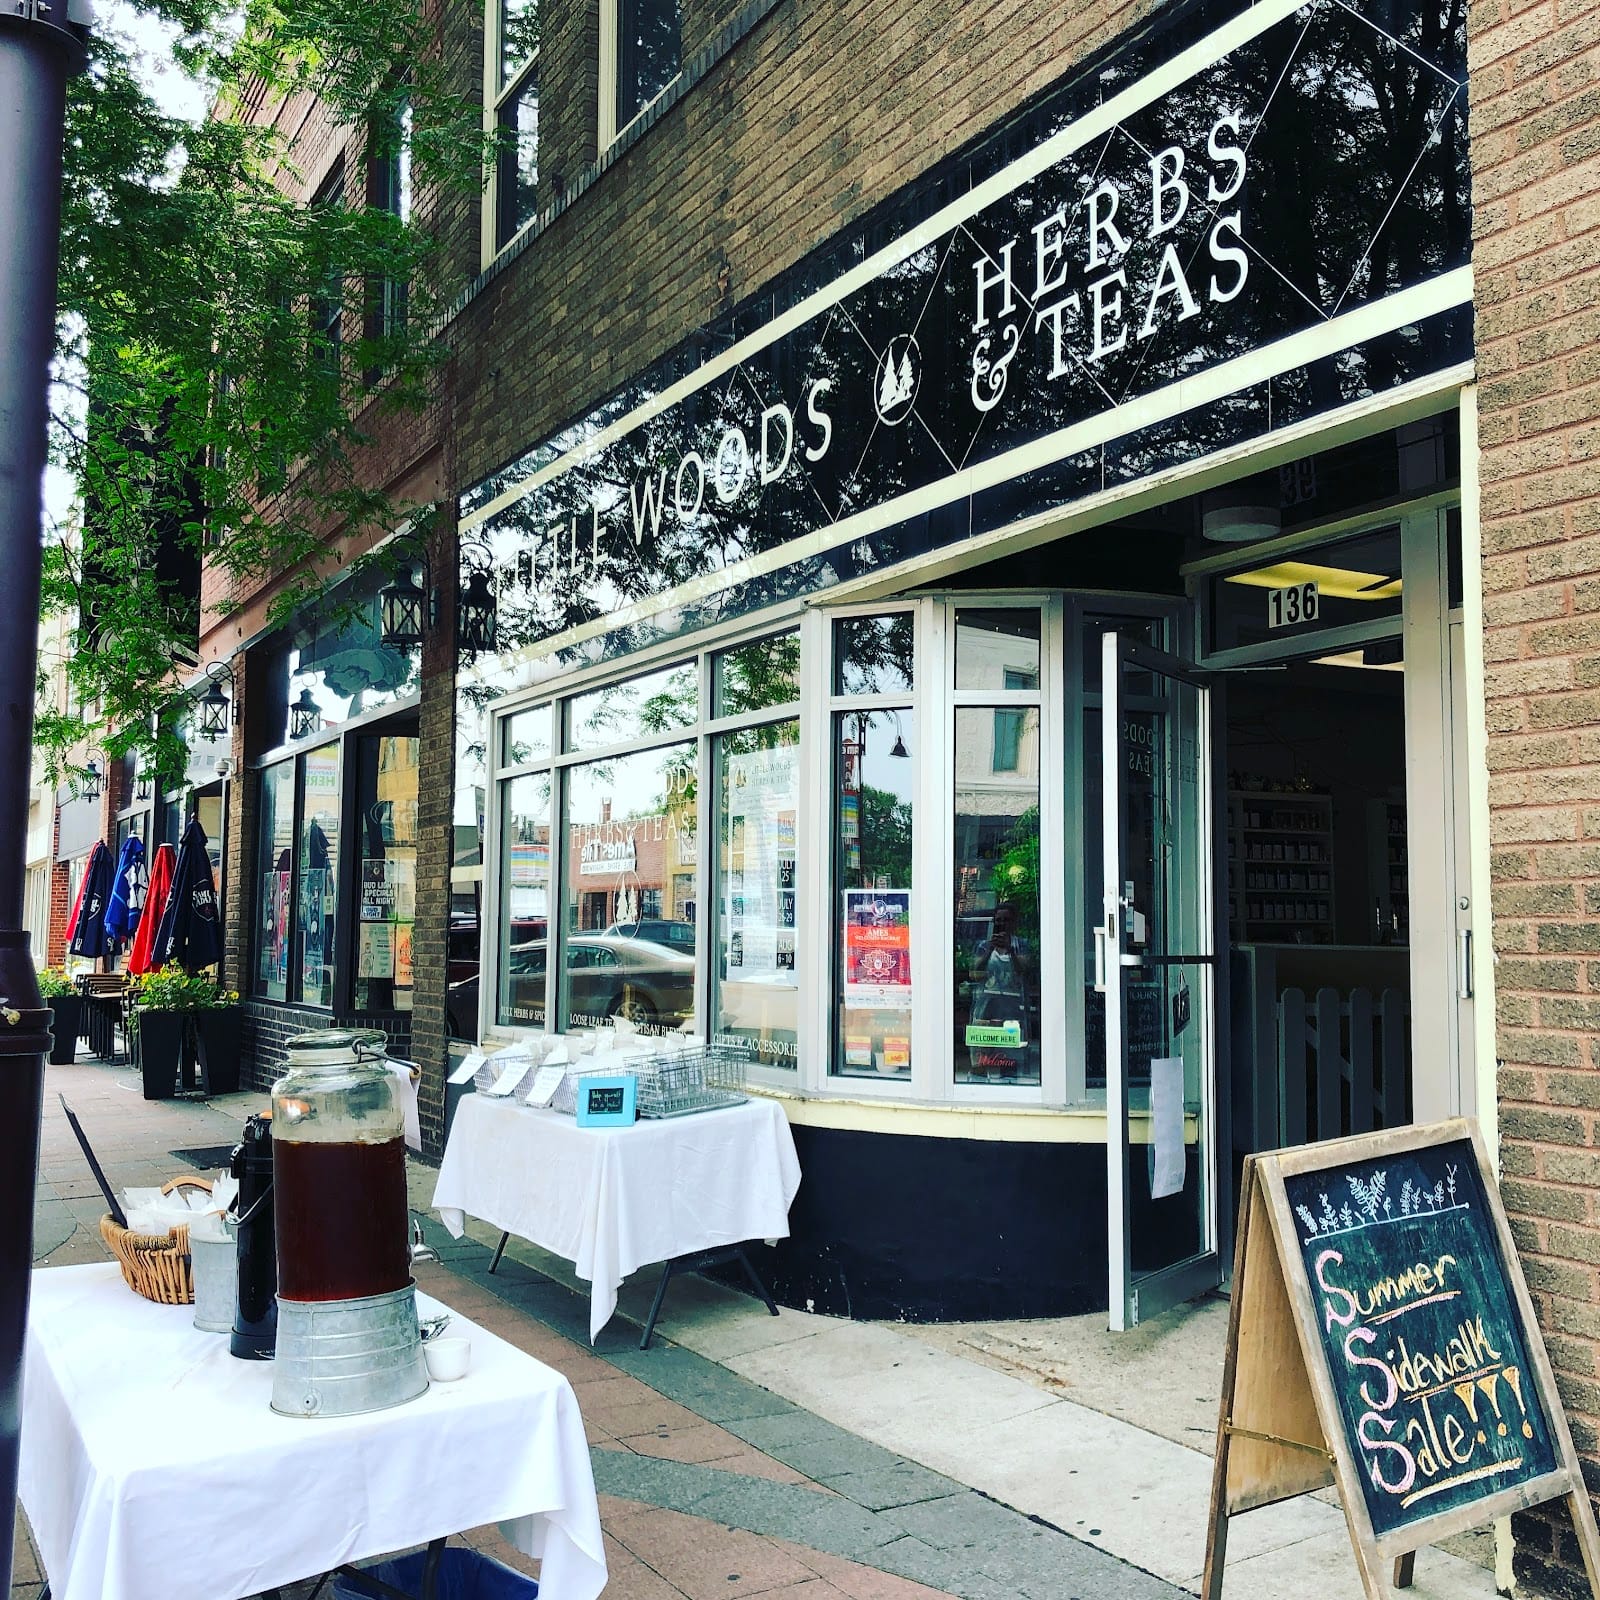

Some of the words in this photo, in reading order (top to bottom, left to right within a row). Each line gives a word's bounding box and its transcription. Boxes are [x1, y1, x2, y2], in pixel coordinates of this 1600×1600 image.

[971, 112, 1247, 333] HERBS
[970, 325, 1019, 412] &
[1034, 210, 1249, 381] TEAS
[630, 378, 833, 546] WOODS
[1271, 582, 1317, 625] 136
[640, 811, 691, 843] TEAS
[570, 1013, 589, 1027] LOOSE
[970, 1034, 1000, 1043] WELCOME
[1000, 1035, 1017, 1044] HERE
[1314, 1249, 1458, 1333] Summer
[1343, 1313, 1502, 1412] Sidewalk
